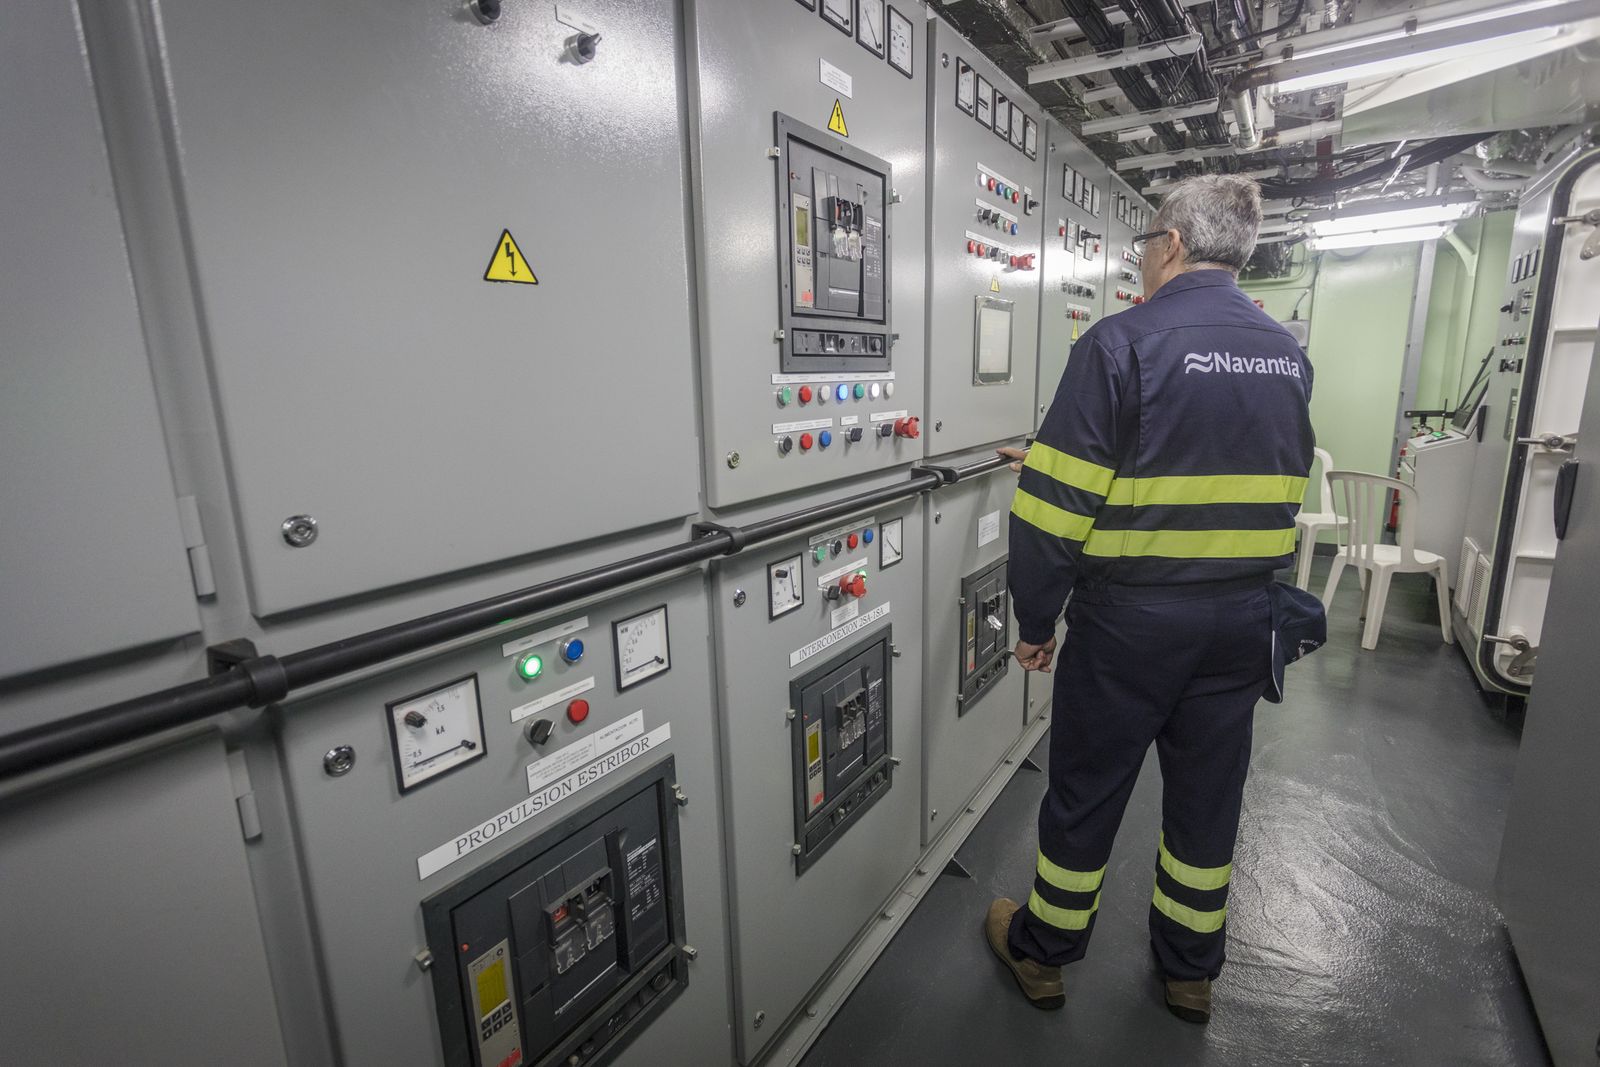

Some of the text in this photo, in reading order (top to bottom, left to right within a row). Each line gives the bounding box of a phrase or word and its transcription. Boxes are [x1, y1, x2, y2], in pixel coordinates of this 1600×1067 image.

[1213, 352, 1300, 378] Navantia
[799, 620, 858, 660] INTERCONEXION
[455, 779, 573, 856] PROPULSION
[577, 736, 651, 787] ESTRIBOR
